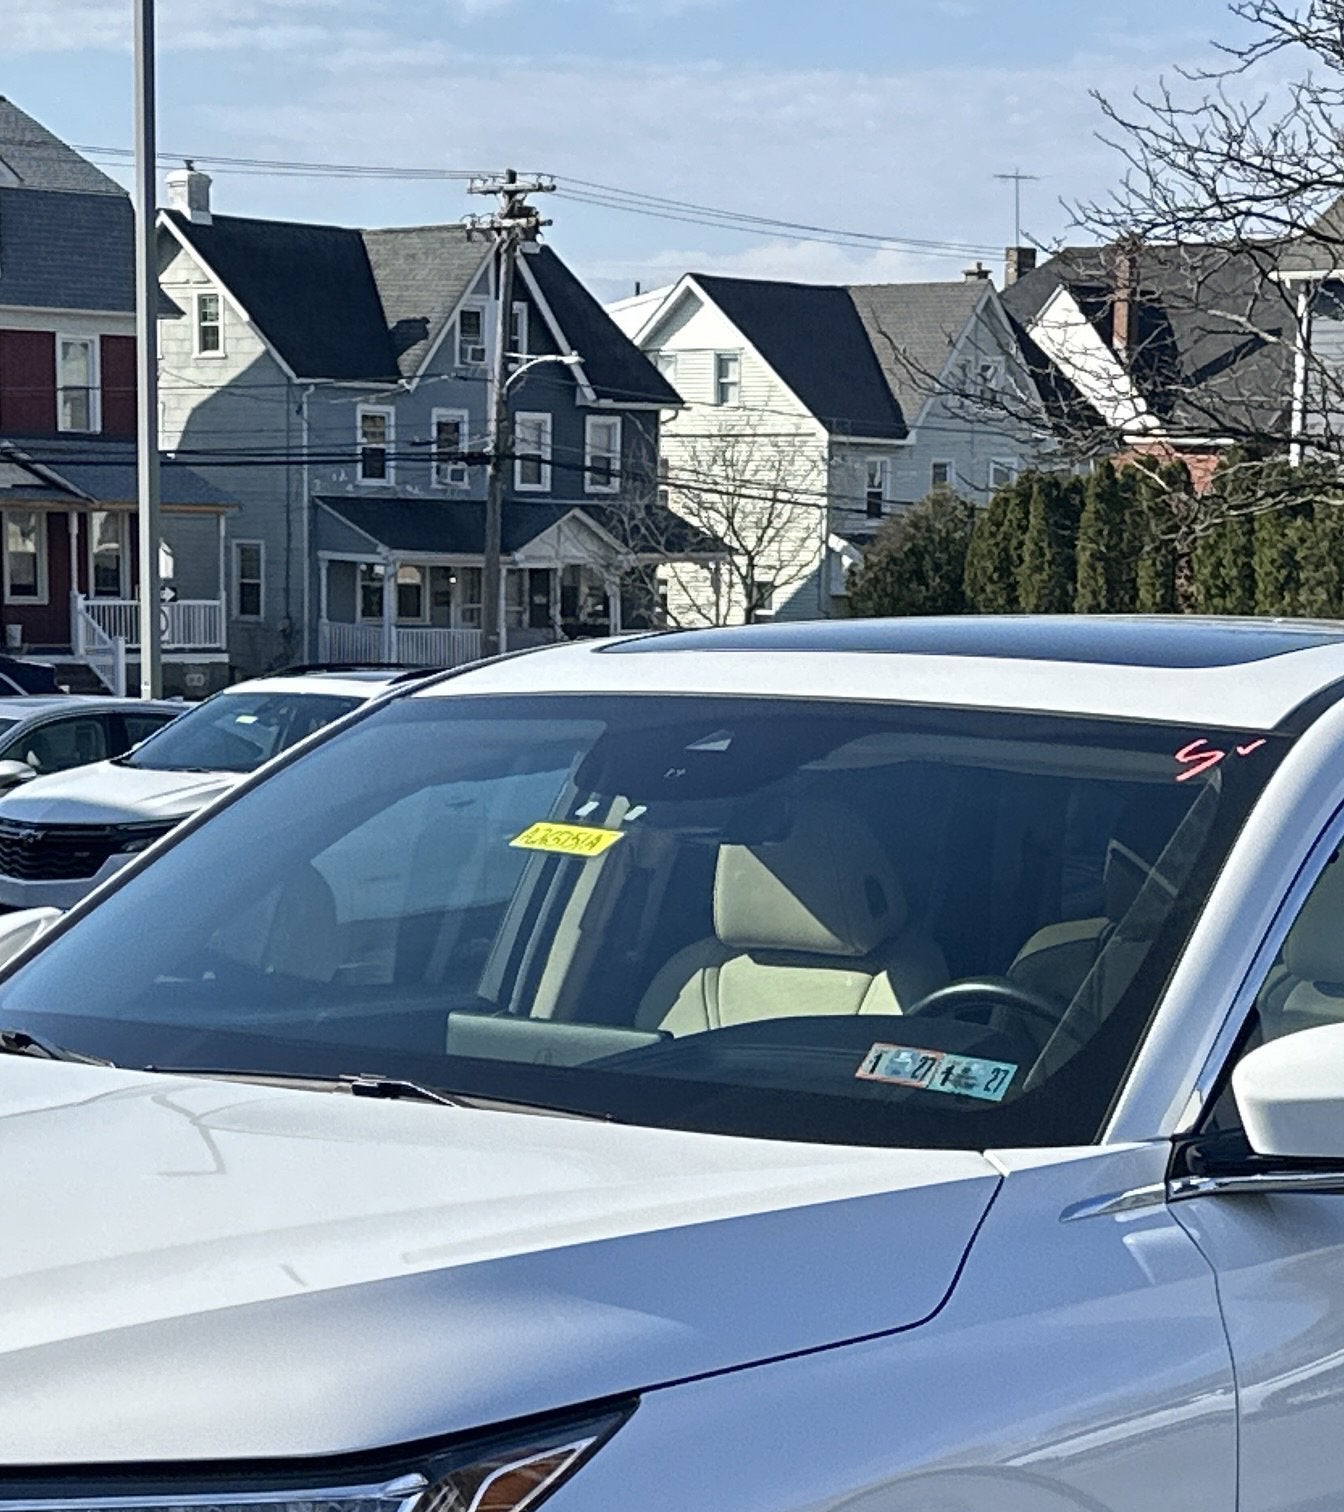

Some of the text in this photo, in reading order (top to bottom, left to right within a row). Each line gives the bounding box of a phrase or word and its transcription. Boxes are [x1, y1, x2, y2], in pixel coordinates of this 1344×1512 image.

[869, 1053, 937, 1081] 1 27
[983, 1067, 1010, 1094] 27
